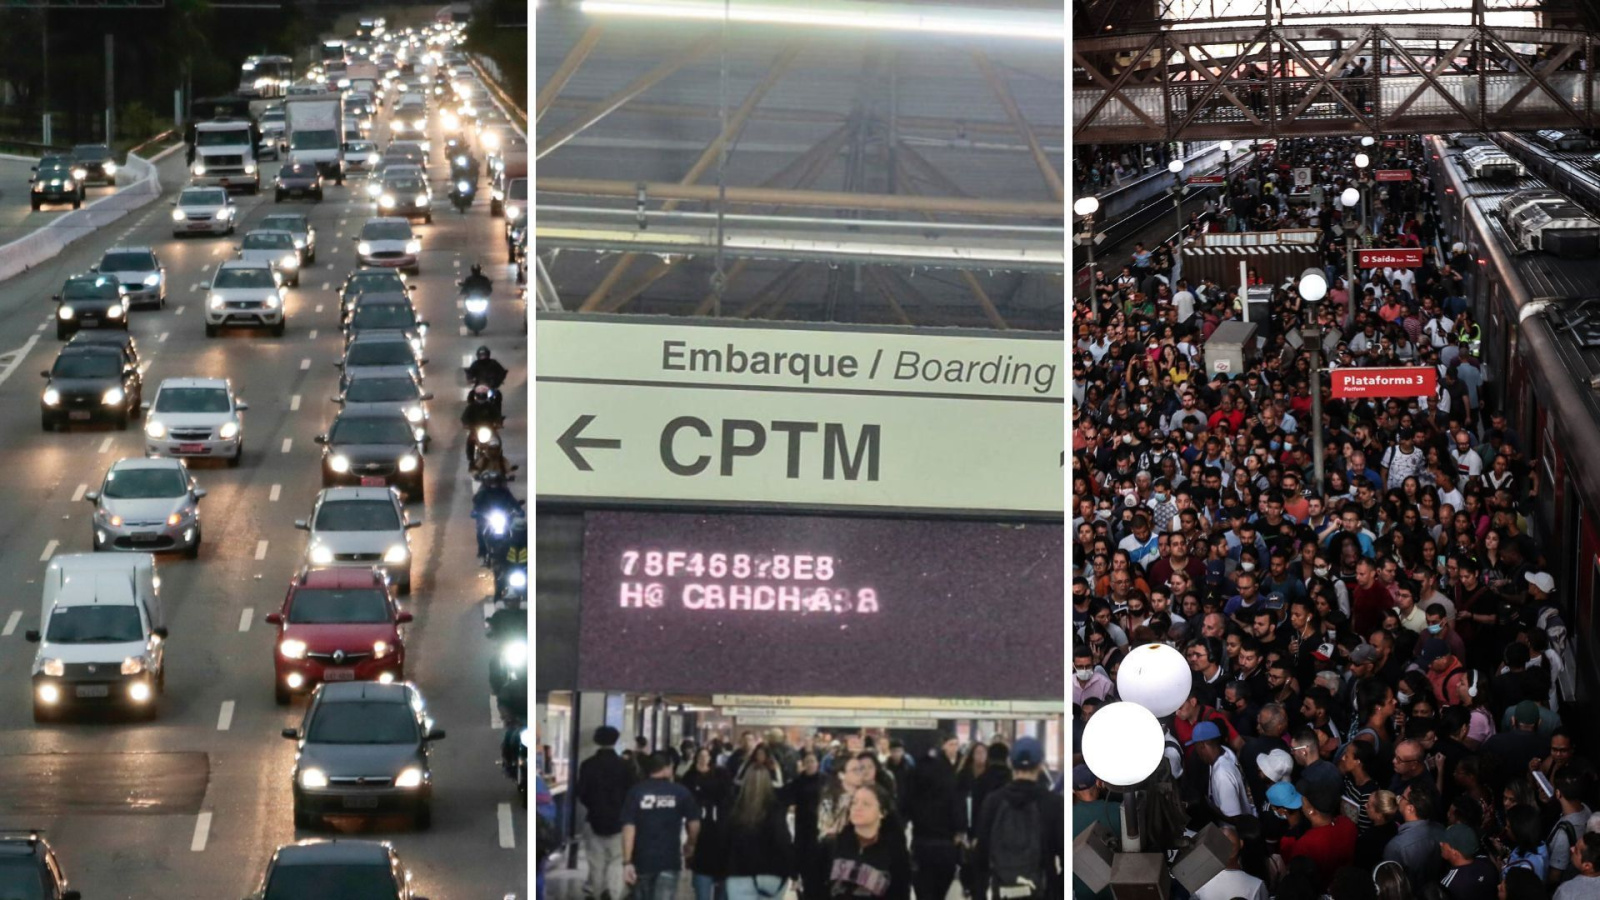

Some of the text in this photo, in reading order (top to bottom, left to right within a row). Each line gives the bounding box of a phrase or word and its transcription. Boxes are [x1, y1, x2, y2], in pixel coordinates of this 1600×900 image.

[1371, 255, 1396, 263] Saída
[661, 340, 858, 383] Embarque
[893, 350, 1057, 393] Boarding
[1343, 375, 1424, 386] Plataforma 3
[659, 415, 881, 481] CPTM
